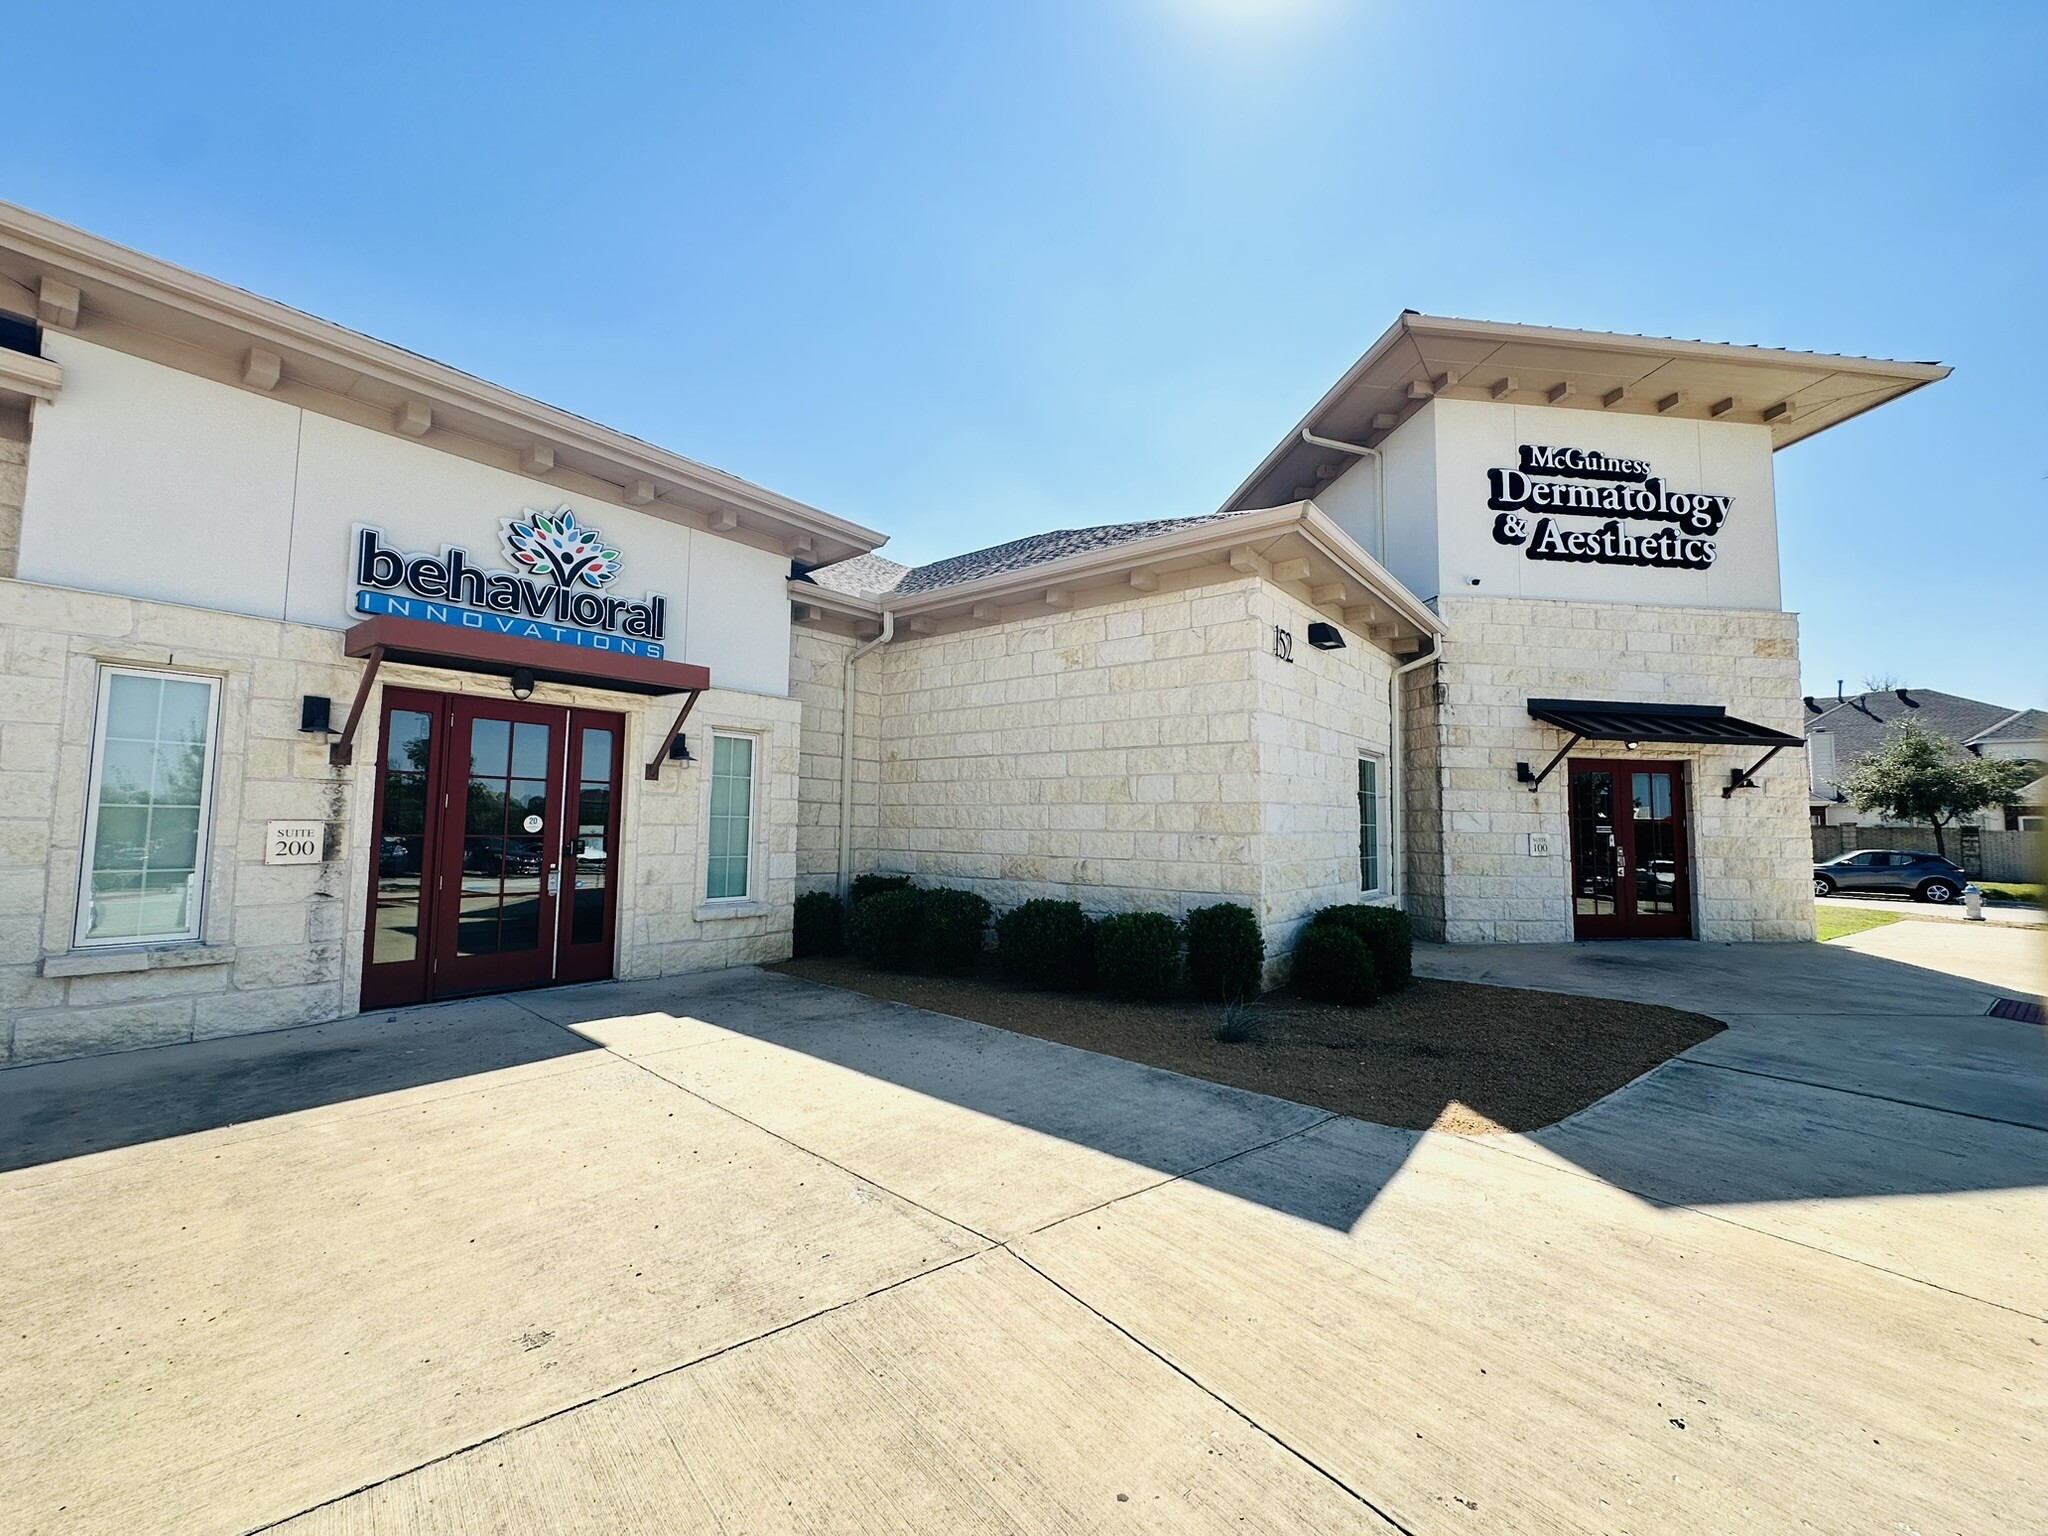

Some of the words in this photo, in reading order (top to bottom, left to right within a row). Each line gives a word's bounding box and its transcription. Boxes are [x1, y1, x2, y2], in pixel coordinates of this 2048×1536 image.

[1530, 445, 1651, 475] McGuiness
[1499, 469, 1736, 528] Dermatology
[1503, 514, 1529, 538] &
[1536, 518, 1717, 563] Aesthetics
[357, 528, 668, 640] behavioral
[363, 594, 661, 659] INNOVATIONS
[1273, 624, 1294, 663] 152
[275, 840, 315, 856] 200
[277, 829, 316, 838] SUITE
[1533, 843, 1548, 852] 100
